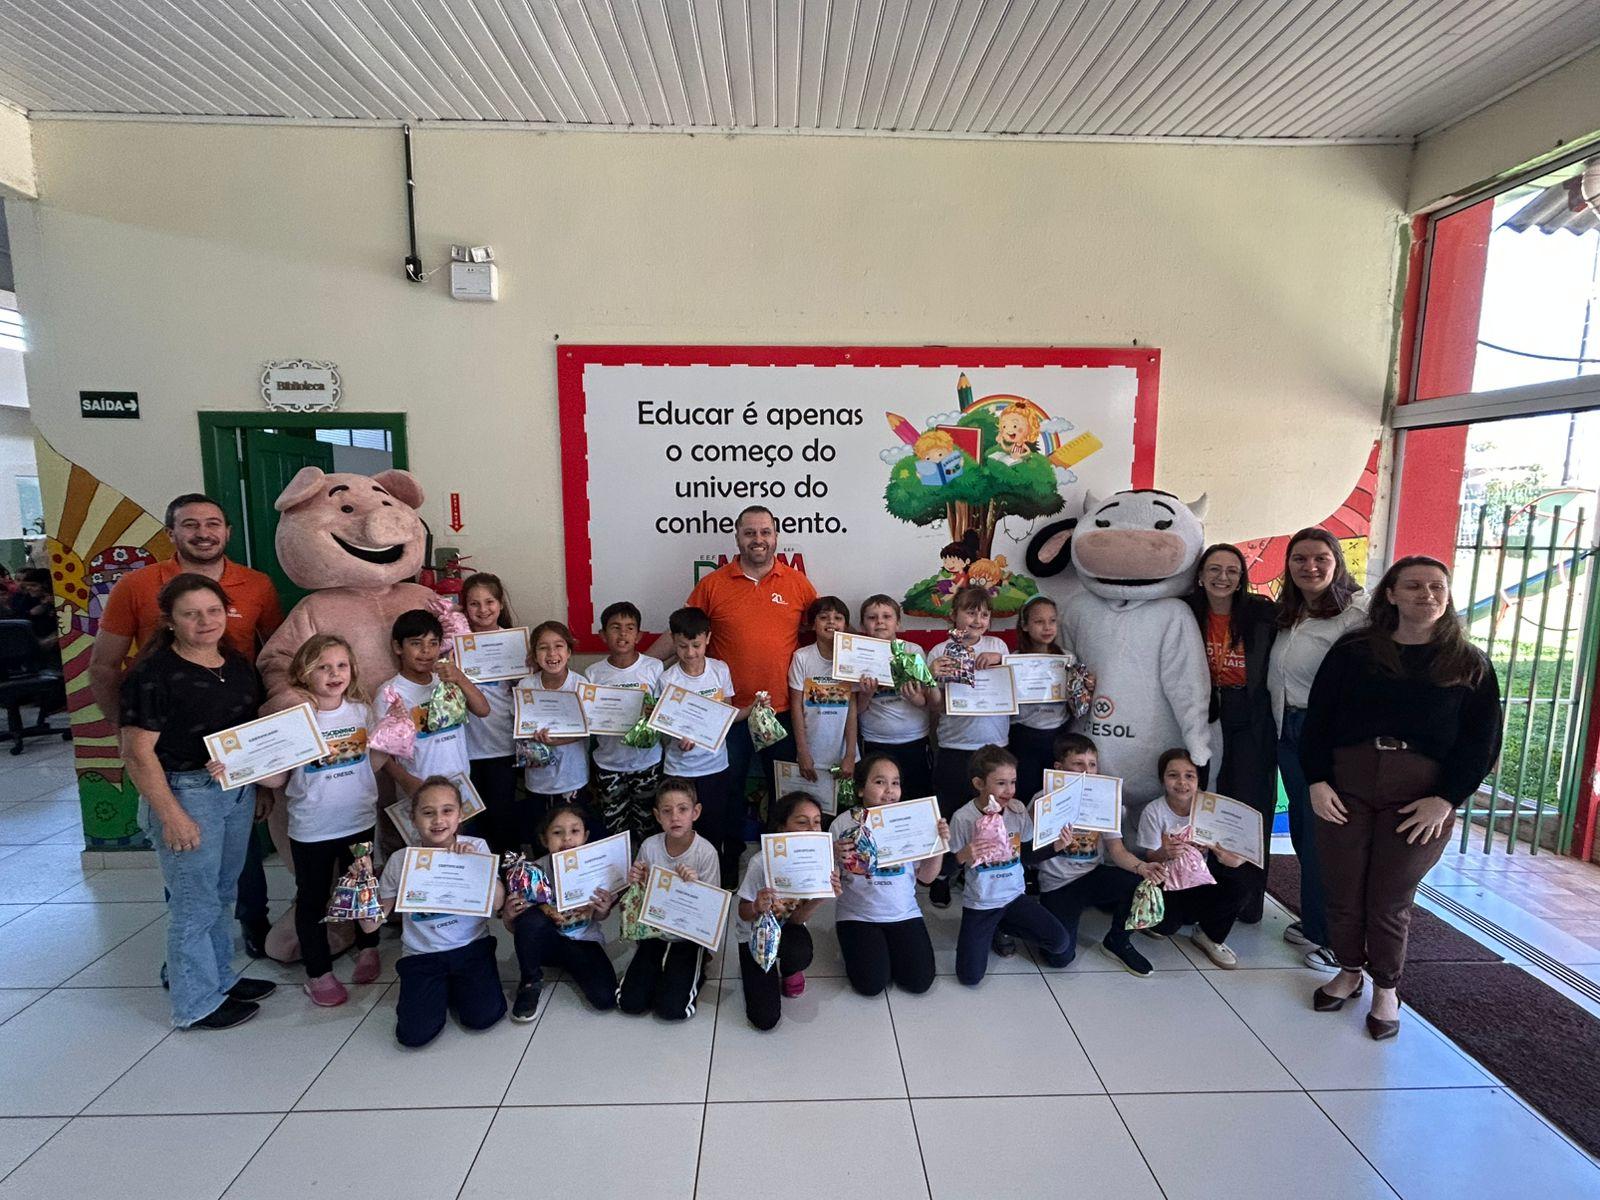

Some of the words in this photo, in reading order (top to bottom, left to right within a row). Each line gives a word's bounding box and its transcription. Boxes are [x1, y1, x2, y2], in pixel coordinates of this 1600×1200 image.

[276, 381, 326, 391] Biblioteca
[81, 394, 125, 412] SAÍDA
[638, 400, 734, 425] Educar
[742, 401, 758, 425] é
[766, 408, 863, 430] apenas
[666, 444, 682, 461] o
[691, 444, 793, 467] começo
[802, 438, 836, 461] do
[675, 476, 786, 498] universo
[794, 474, 828, 498] do
[655, 510, 848, 534] conheento.
